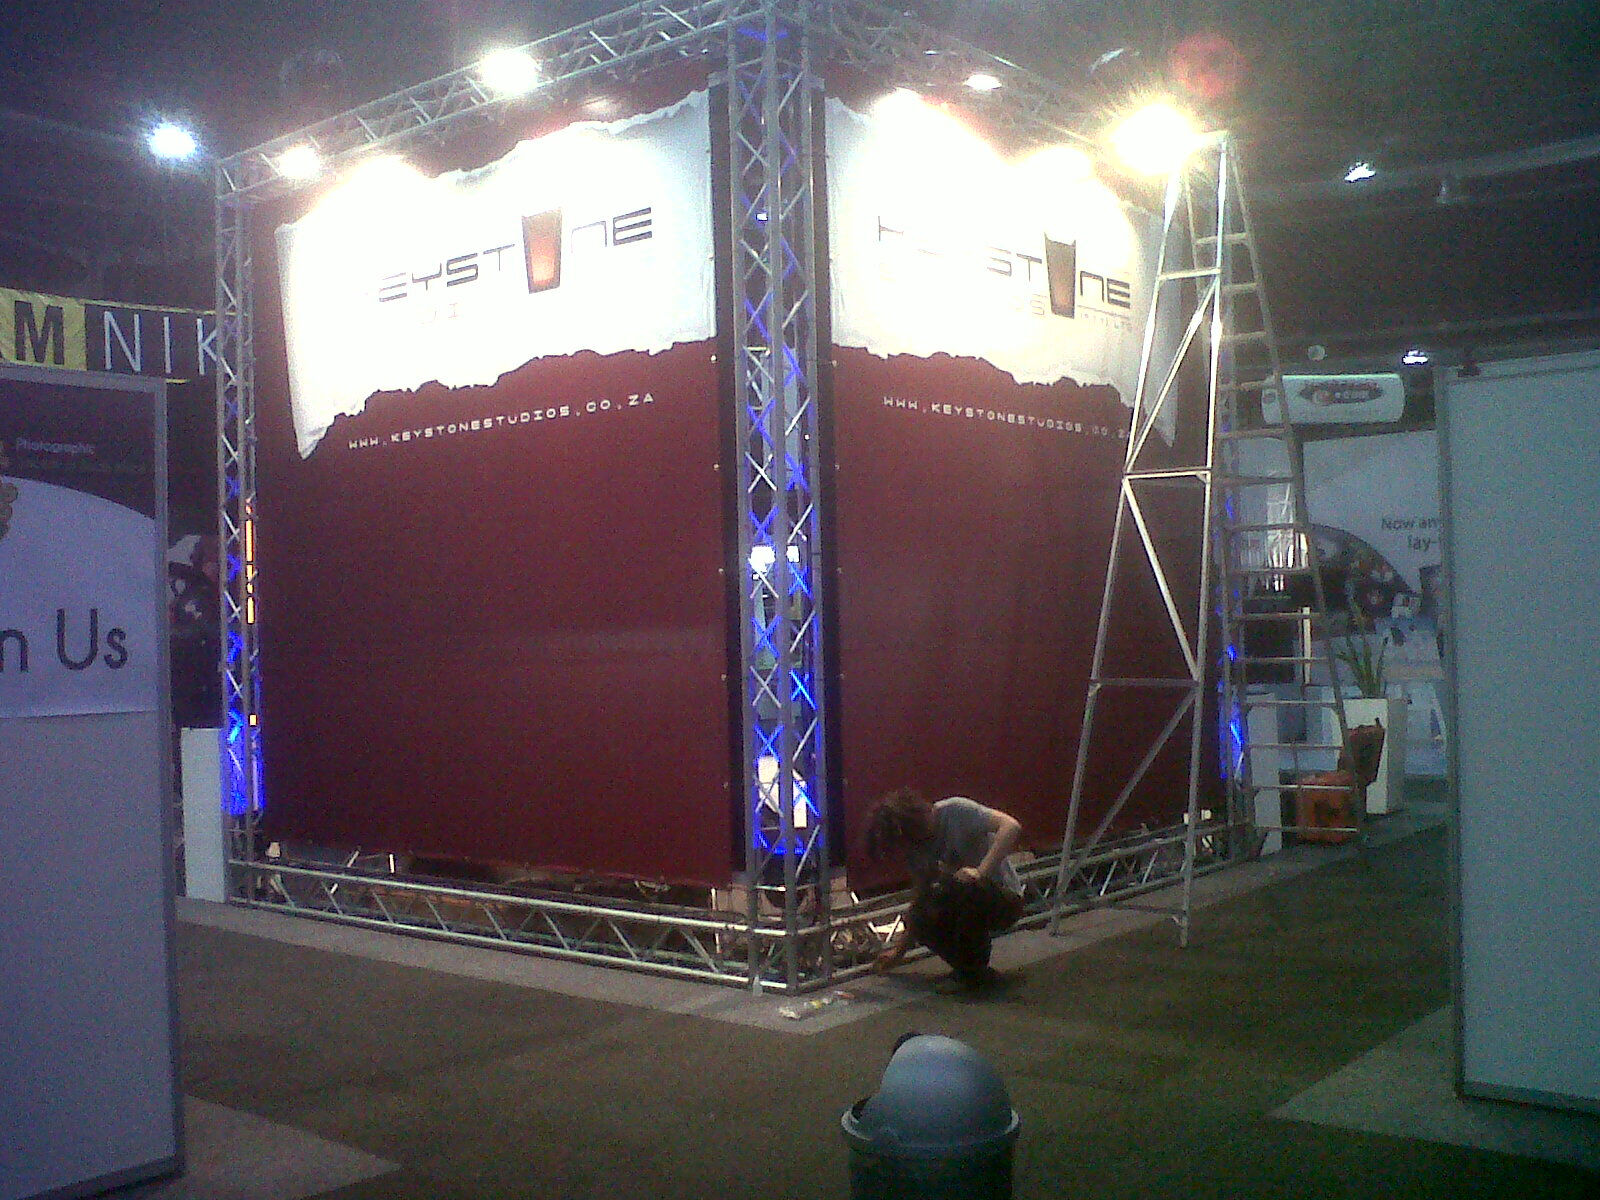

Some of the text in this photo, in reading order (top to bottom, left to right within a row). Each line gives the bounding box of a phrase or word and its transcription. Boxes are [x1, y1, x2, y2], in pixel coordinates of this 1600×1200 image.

[348, 392, 655, 450] WWW.KEYSTONESTUDIOS.CO.ZA
[882, 396, 1131, 440] WWW.KEYSTONESTUDIOS.CO.Z
[56, 608, 129, 671] Us
